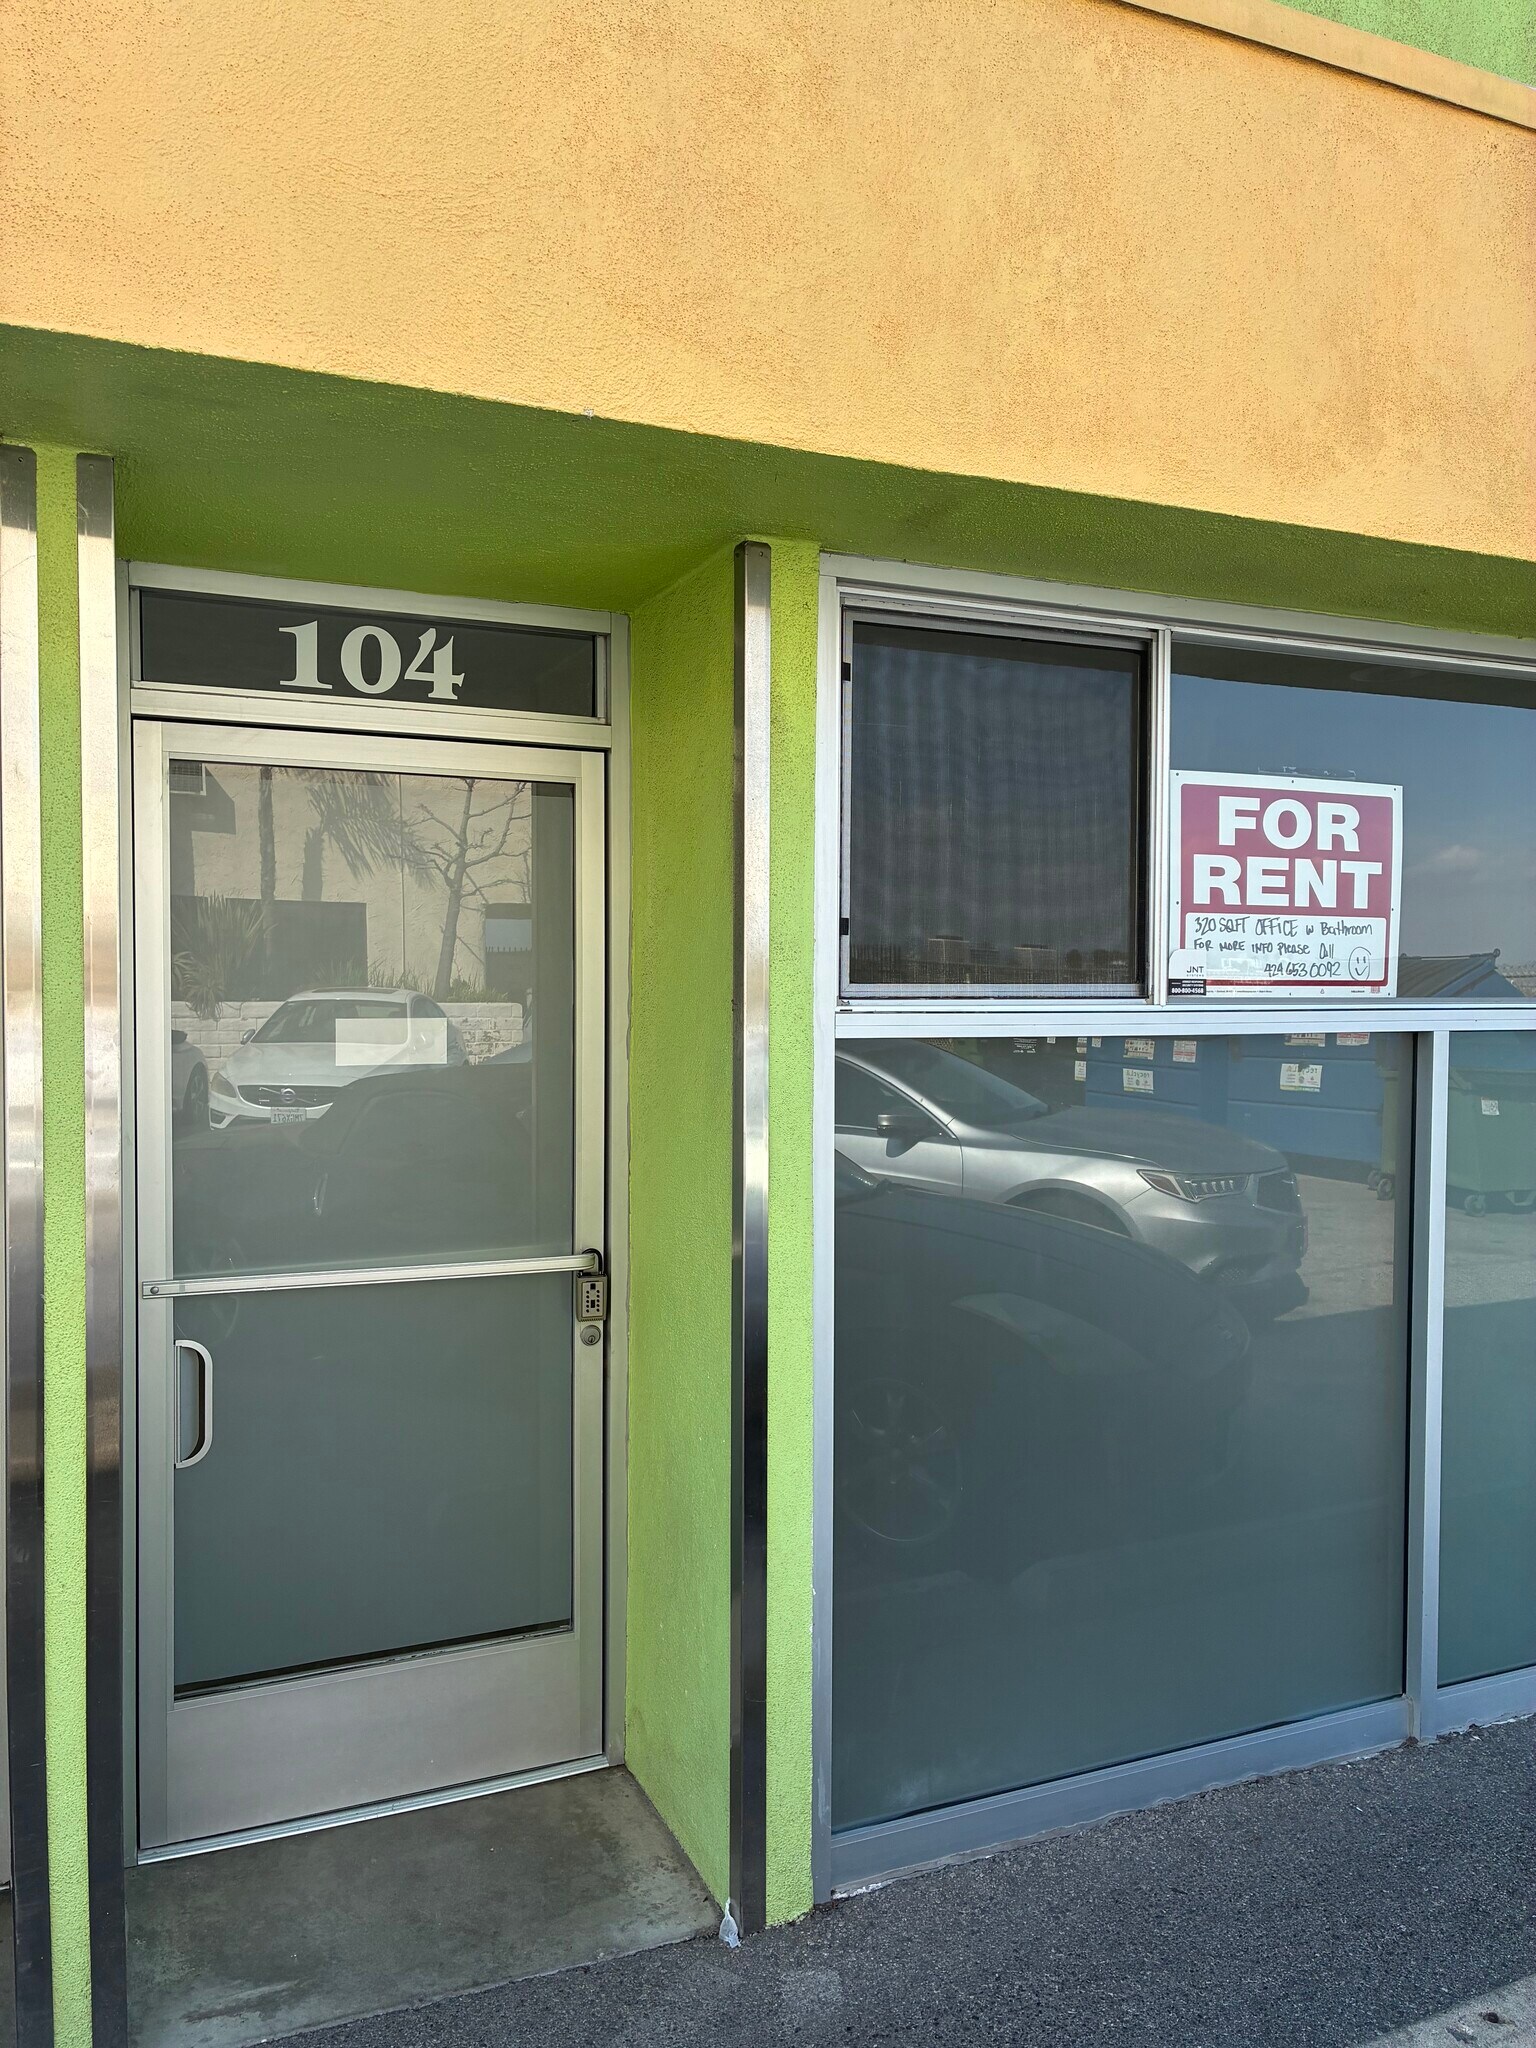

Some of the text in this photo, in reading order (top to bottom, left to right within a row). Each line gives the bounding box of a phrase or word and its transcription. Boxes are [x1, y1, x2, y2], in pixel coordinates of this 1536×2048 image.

[278, 620, 465, 700] 104
[1219, 796, 1360, 852] FOR
[1193, 854, 1383, 909] RENT
[1194, 917, 1216, 936] 320
[1219, 916, 1250, 934] SQFT
[1320, 920, 1373, 936] Bathroom
[1219, 941, 1245, 952] MORE
[1251, 943, 1273, 954] INFO
